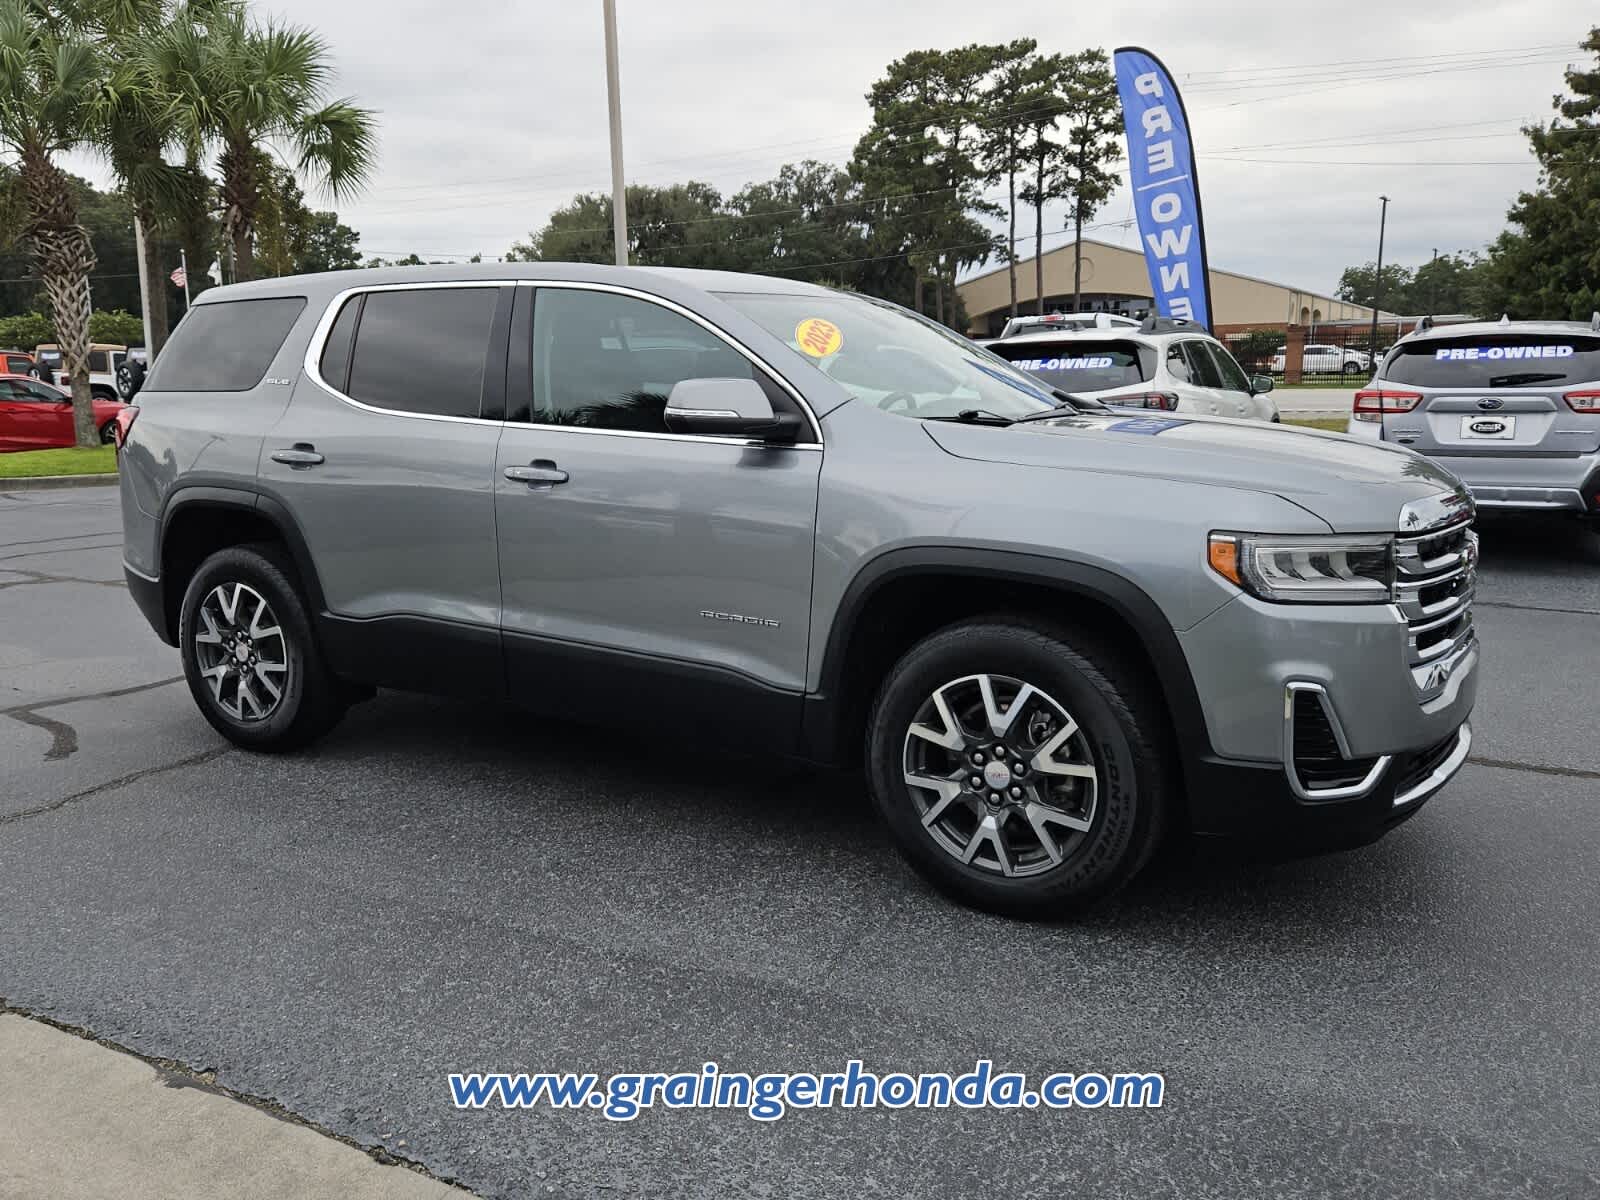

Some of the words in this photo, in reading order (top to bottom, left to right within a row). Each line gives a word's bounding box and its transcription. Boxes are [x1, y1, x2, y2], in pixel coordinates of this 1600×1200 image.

[803, 320, 835, 354] 2023
[1435, 345, 1574, 360] PRE-OWNED
[700, 610, 779, 627] ACADIA
[1053, 742, 1122, 890] CONTINENTA
